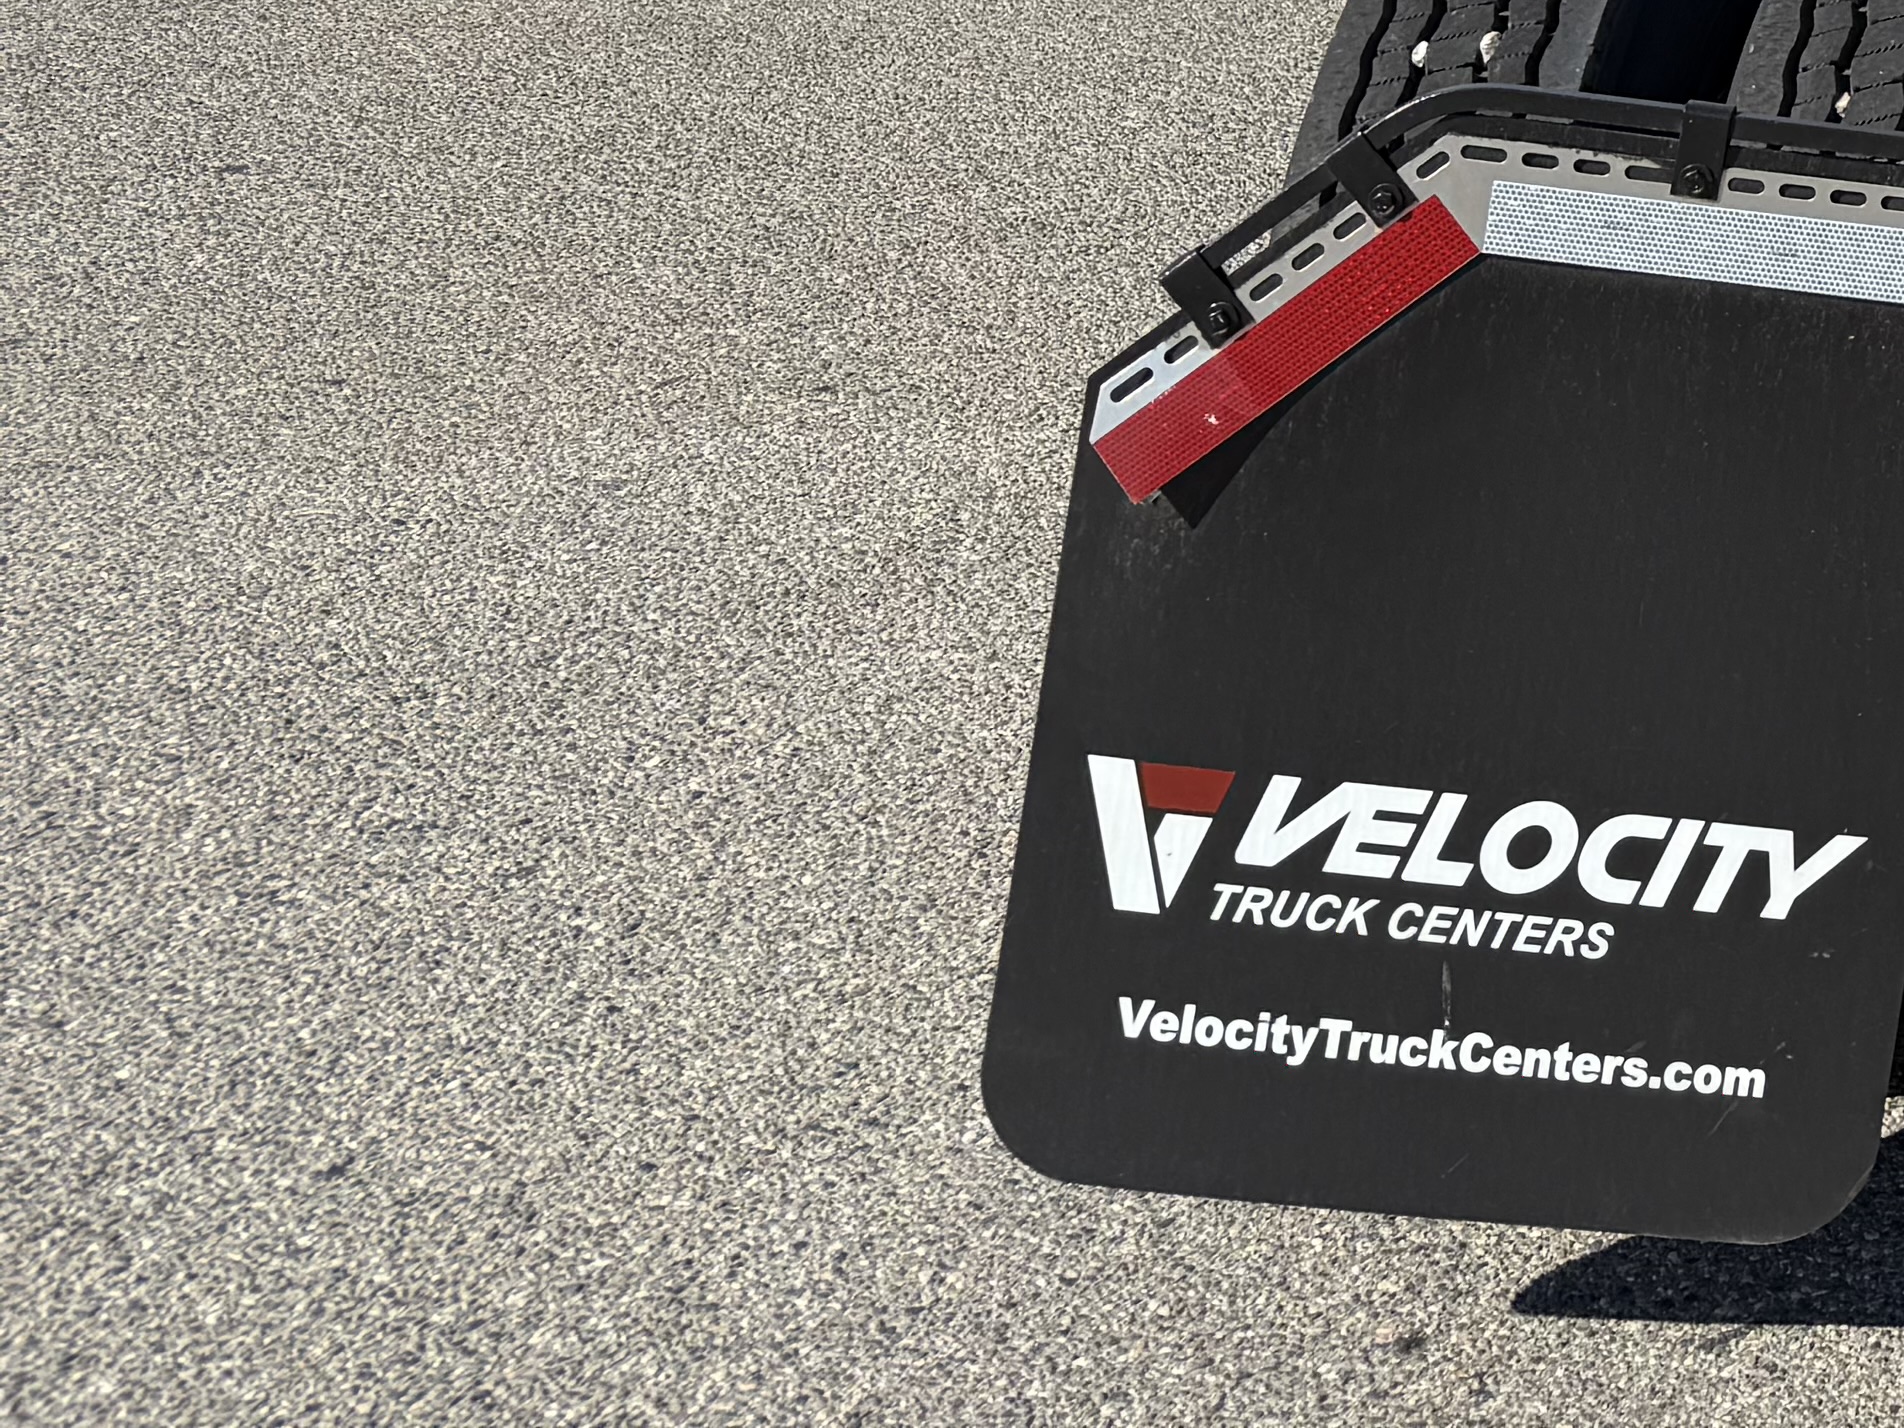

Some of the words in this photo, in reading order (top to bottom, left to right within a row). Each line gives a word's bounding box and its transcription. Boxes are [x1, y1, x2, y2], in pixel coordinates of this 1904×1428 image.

[1235, 774, 1869, 921] VELOCITY
[1210, 882, 1381, 937] TRUCK
[1387, 902, 1615, 960] CENTERS
[1118, 996, 1766, 1099] VelocityTruckCenters.com
